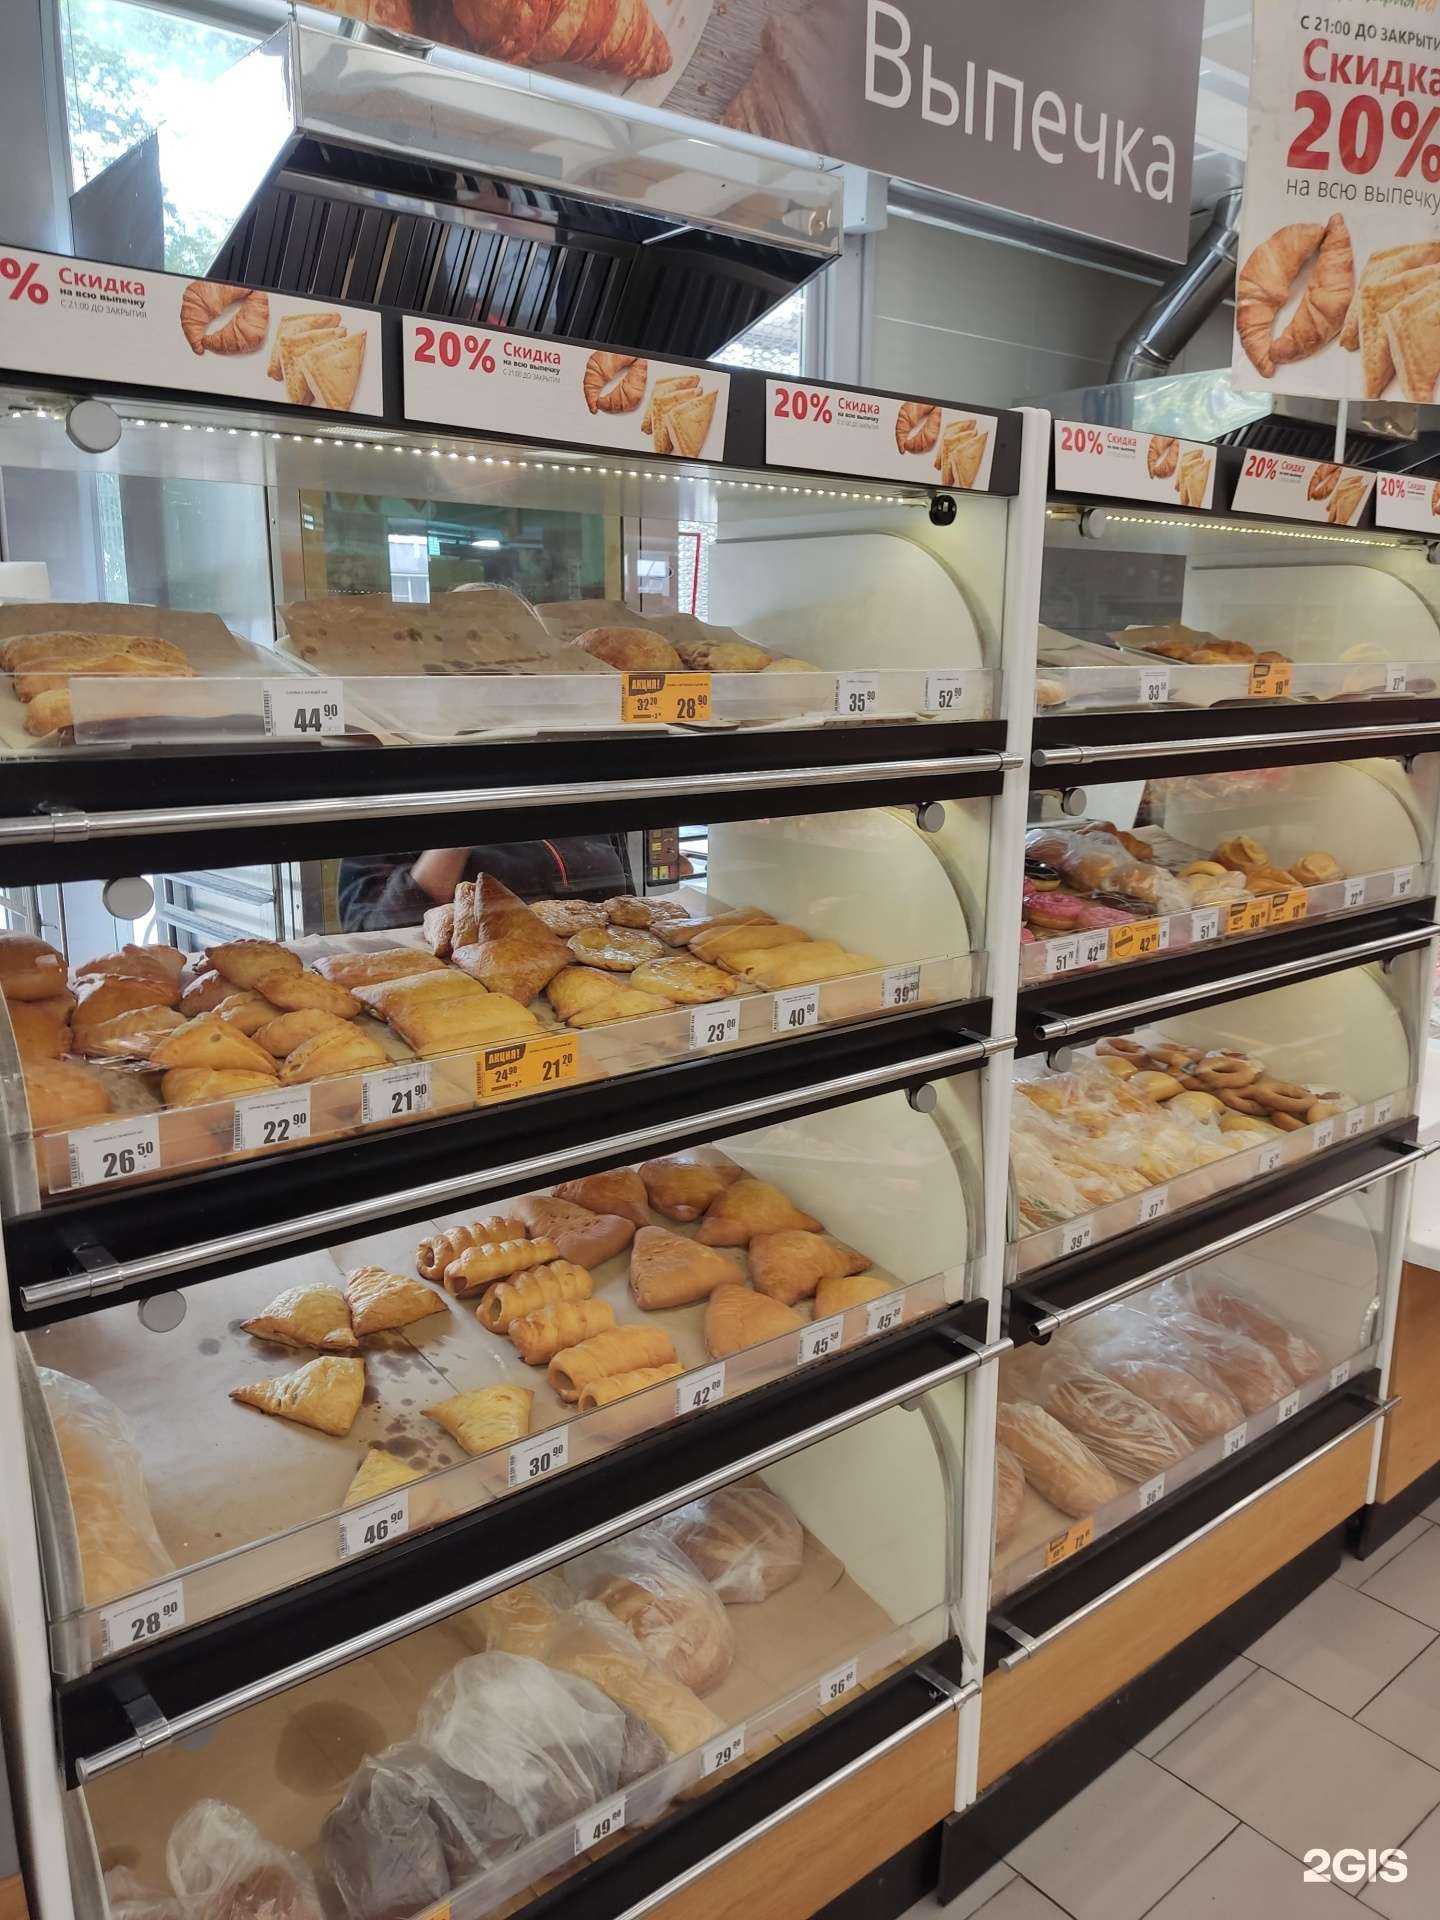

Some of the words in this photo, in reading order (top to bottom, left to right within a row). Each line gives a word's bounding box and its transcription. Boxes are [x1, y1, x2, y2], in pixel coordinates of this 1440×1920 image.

[1300, 15, 1309, 30] С
[1314, 16, 1351, 36] 21:00
[1354, 23, 1377, 40] ДО
[1303, 37, 1440, 98] Скидка
[865, 0, 1176, 204] Выпечка
[1286, 89, 1440, 184] 20%
[1286, 178, 1310, 197] на
[1317, 180, 1367, 200] всю
[1364, 184, 1440, 216] выпечку
[0, 257, 49, 305] %
[58, 267, 146, 297] Скидка
[59, 287, 73, 298] на
[75, 289, 98, 301] всю
[99, 292, 147, 309] выпечку
[414, 326, 496, 374] 20%
[503, 341, 562, 366] Скидка
[503, 358, 512, 367] на
[513, 360, 528, 370] всю
[529, 363, 561, 375] выпечку
[774, 387, 833, 425] 20%
[837, 396, 880, 415] Скидка
[1061, 426, 1104, 456] 20%
[1107, 432, 1137, 448] Скидка
[1245, 455, 1277, 481] 20%
[1280, 460, 1306, 474] Скидка
[1380, 476, 1406, 499] 20%
[294, 708, 322, 732] 44
[677, 698, 696, 718] 28
[788, 1007, 805, 1027] 40
[707, 1023, 725, 1043] 23
[542, 1059, 560, 1081] 21
[391, 1090, 412, 1114] 21
[263, 1118, 290, 1144] 22
[102, 1148, 135, 1178] 26
[693, 1386, 710, 1406] 42
[529, 1452, 551, 1476] 30
[363, 1519, 389, 1544] 46
[131, 1611, 161, 1642] 28
[715, 1746, 731, 1768] 29
[593, 1818, 611, 1839] 49
